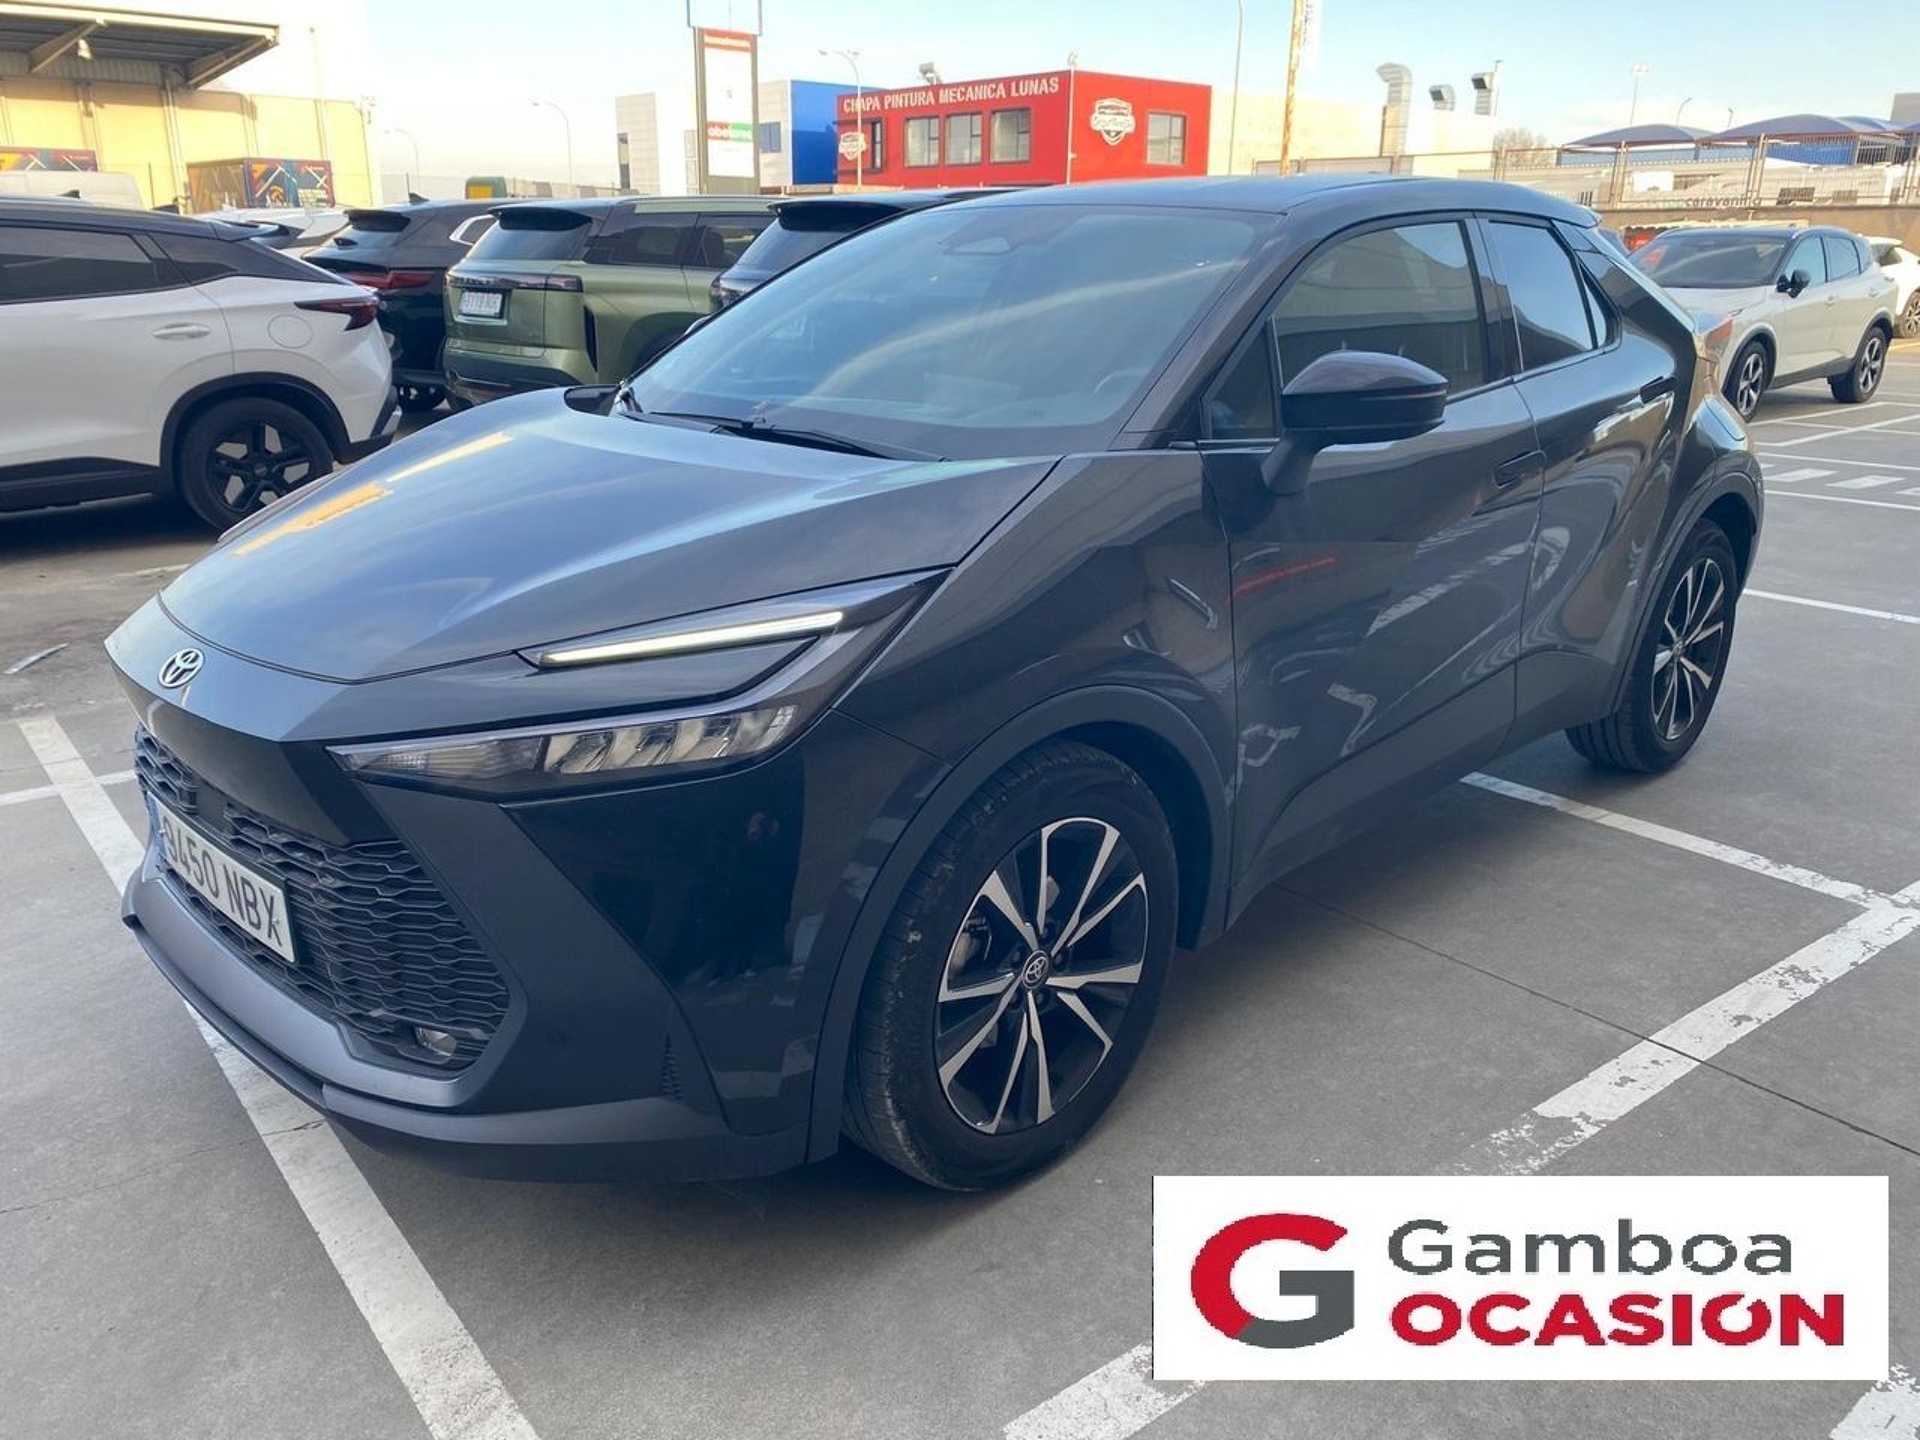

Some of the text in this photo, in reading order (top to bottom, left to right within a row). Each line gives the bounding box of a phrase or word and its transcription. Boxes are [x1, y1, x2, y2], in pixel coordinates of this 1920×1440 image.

[844, 77, 1060, 113] CHAPA PINTURA MECANICA LUNAS
[163, 815, 283, 947] 9450 NBX
